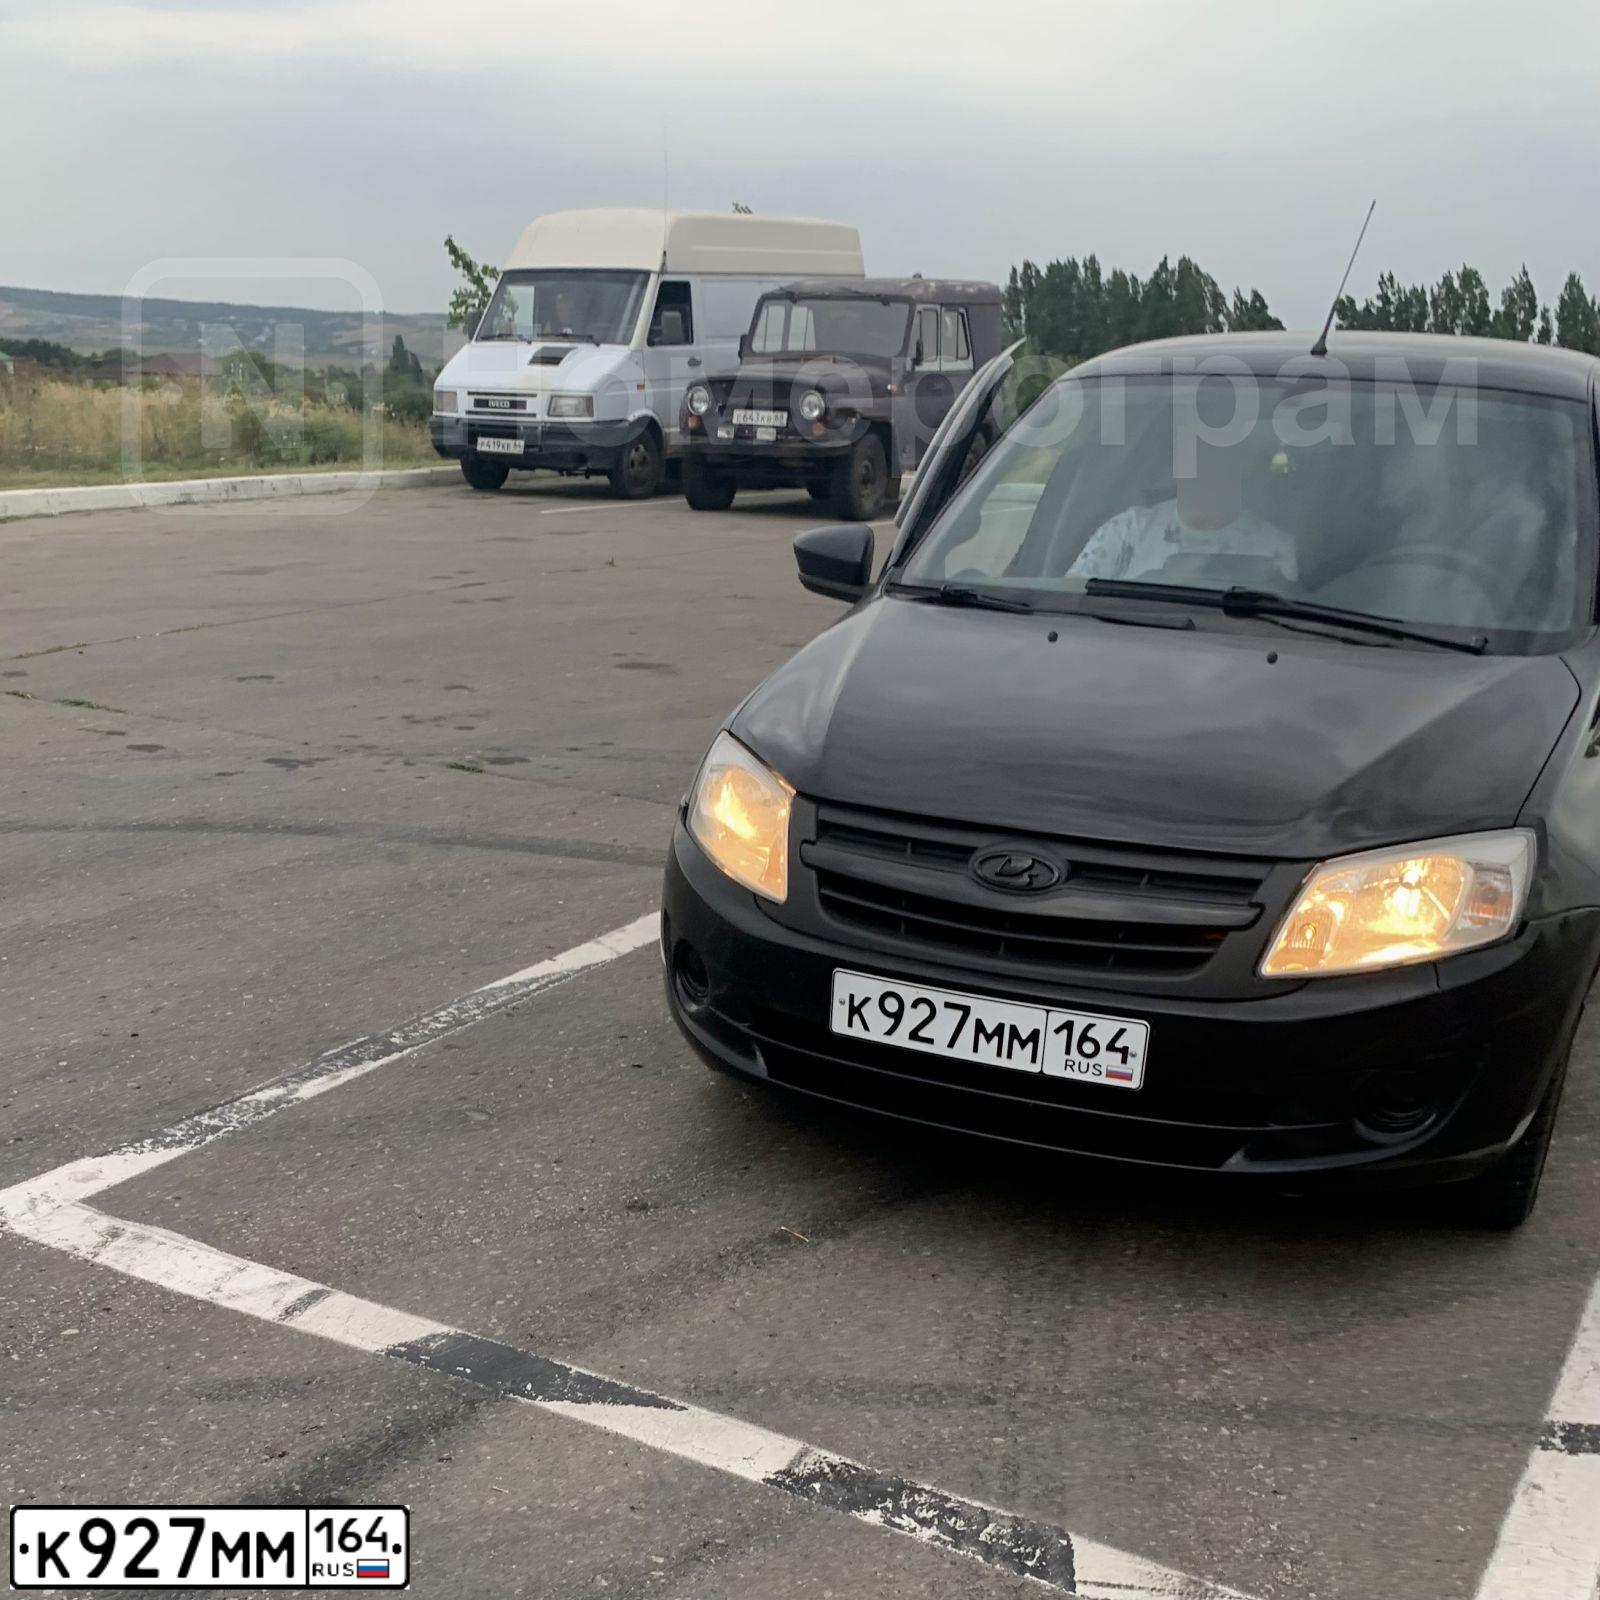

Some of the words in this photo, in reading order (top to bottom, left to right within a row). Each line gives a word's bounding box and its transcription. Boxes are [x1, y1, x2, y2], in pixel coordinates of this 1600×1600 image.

[488, 400, 511, 408] IVECO
[847, 990, 1041, 1064] К927ММ
[1053, 1019, 1130, 1065] 164
[1064, 1058, 1103, 1077] RUS
